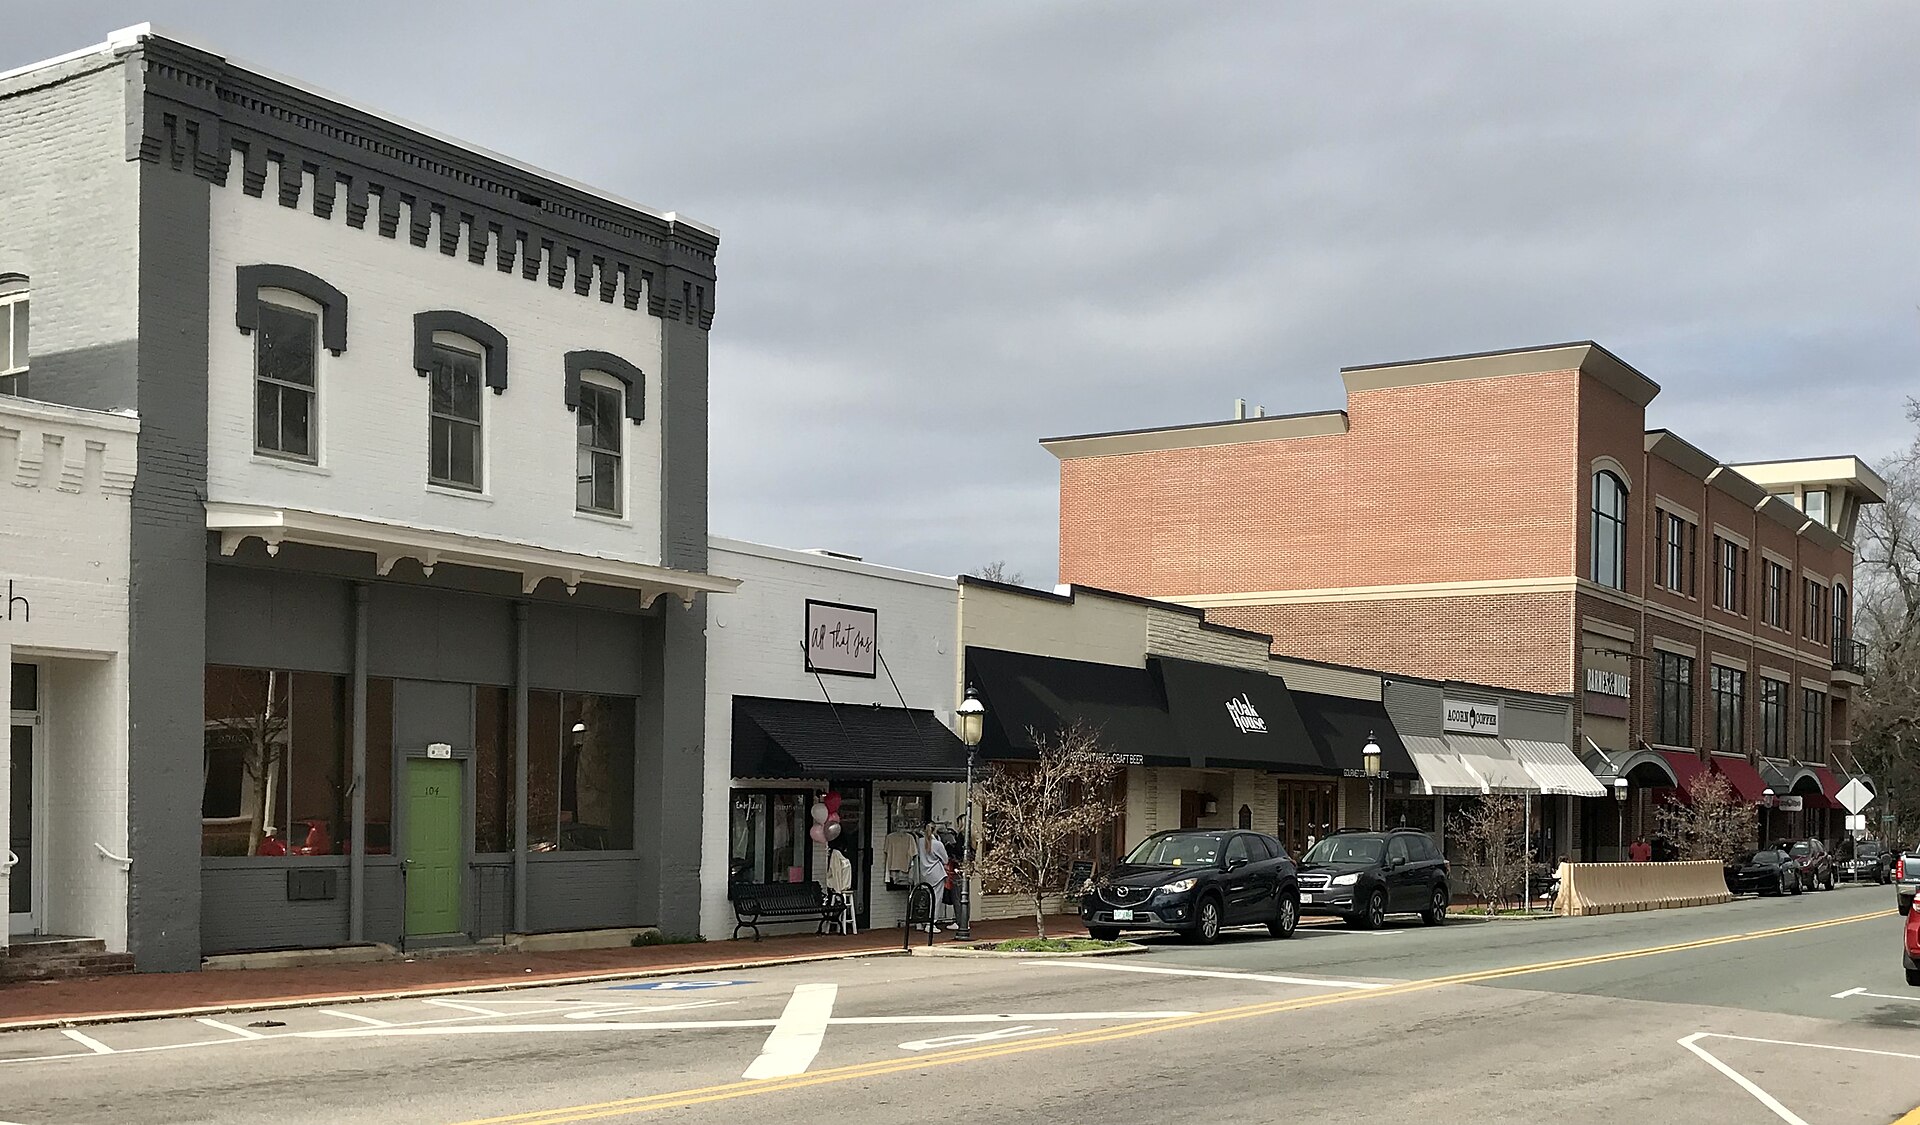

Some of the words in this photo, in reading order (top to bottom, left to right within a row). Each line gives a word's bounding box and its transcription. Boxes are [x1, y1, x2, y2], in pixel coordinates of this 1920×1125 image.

[0, 579, 30, 622] h
[1232, 692, 1260, 717] Oak
[1229, 707, 1268, 734] House
[1447, 709, 1469, 723] ACORN
[1475, 712, 1497, 726] COFFEE
[1112, 753, 1130, 764] CRAFT
[1130, 754, 1144, 765] BEER
[425, 786, 440, 796] 104
